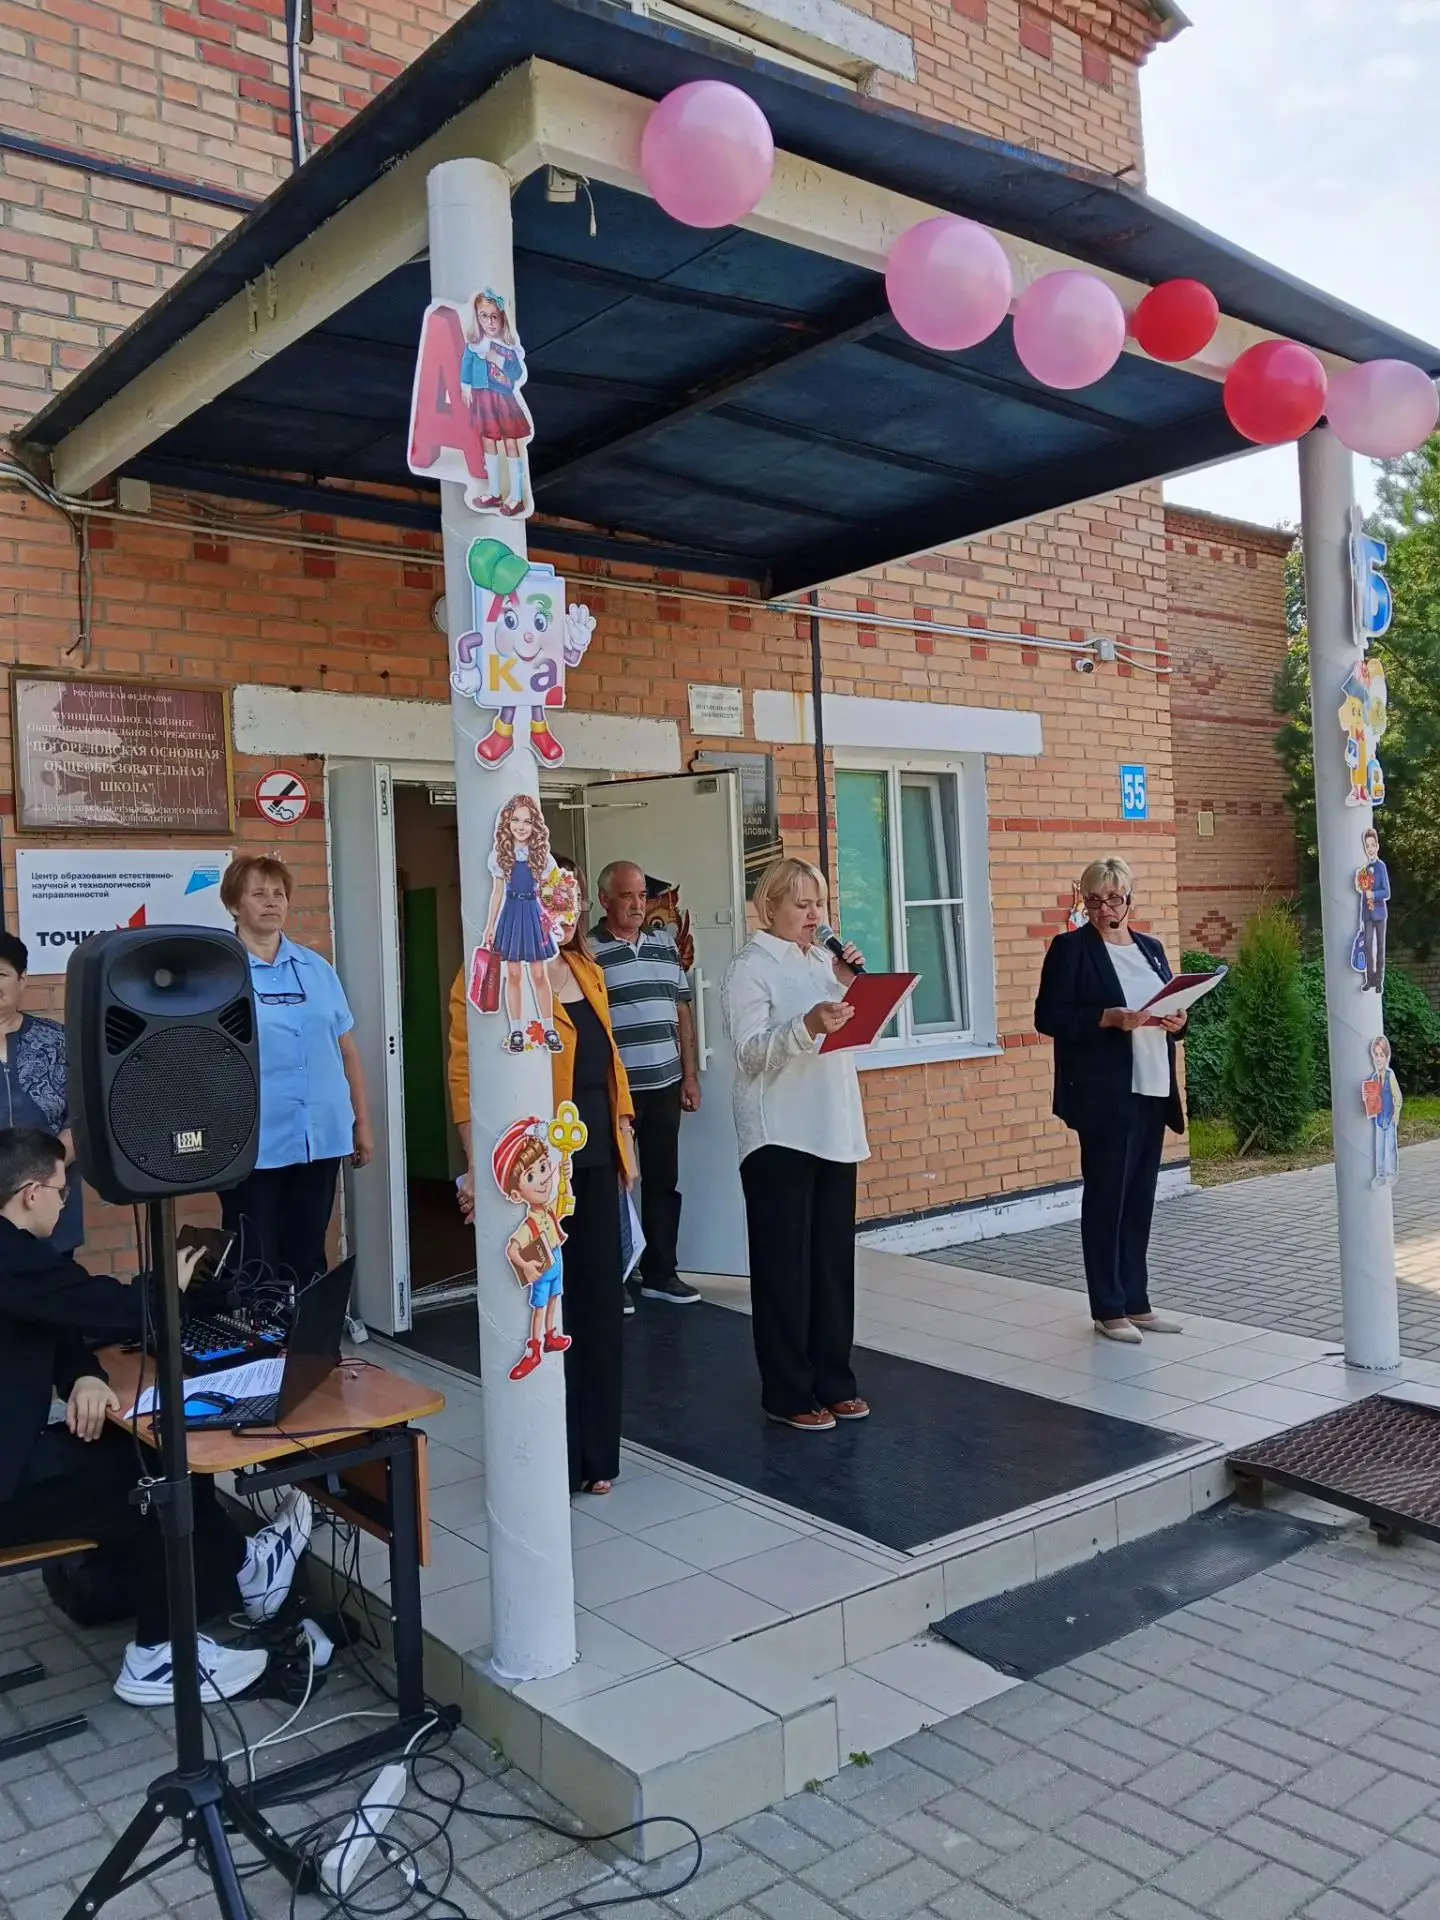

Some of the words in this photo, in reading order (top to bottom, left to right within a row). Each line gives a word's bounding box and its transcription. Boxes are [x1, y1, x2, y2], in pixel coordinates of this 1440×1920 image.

[410, 305, 489, 480] А
[73, 690, 125, 700] РОССИЙСКАЯ
[127, 693, 172, 703] ФЕДЕРАЦИЯ
[153, 731, 217, 741] УЧРЕЖДЕНИЕ
[150, 746, 219, 760] ОСНОВНАЯ
[44, 760, 205, 777] ОБЩЕОБРАЗОВАТЕЛЬНАЯ
[1123, 773, 1146, 811] 55
[31, 872, 59, 881] Центр
[61, 872, 117, 881] образования
[118, 872, 174, 880] естественно-
[32, 882, 69, 891] научной
[79, 881, 151, 890] технологической
[32, 890, 110, 900] направленностей
[36, 930, 106, 947] ТОЧК
